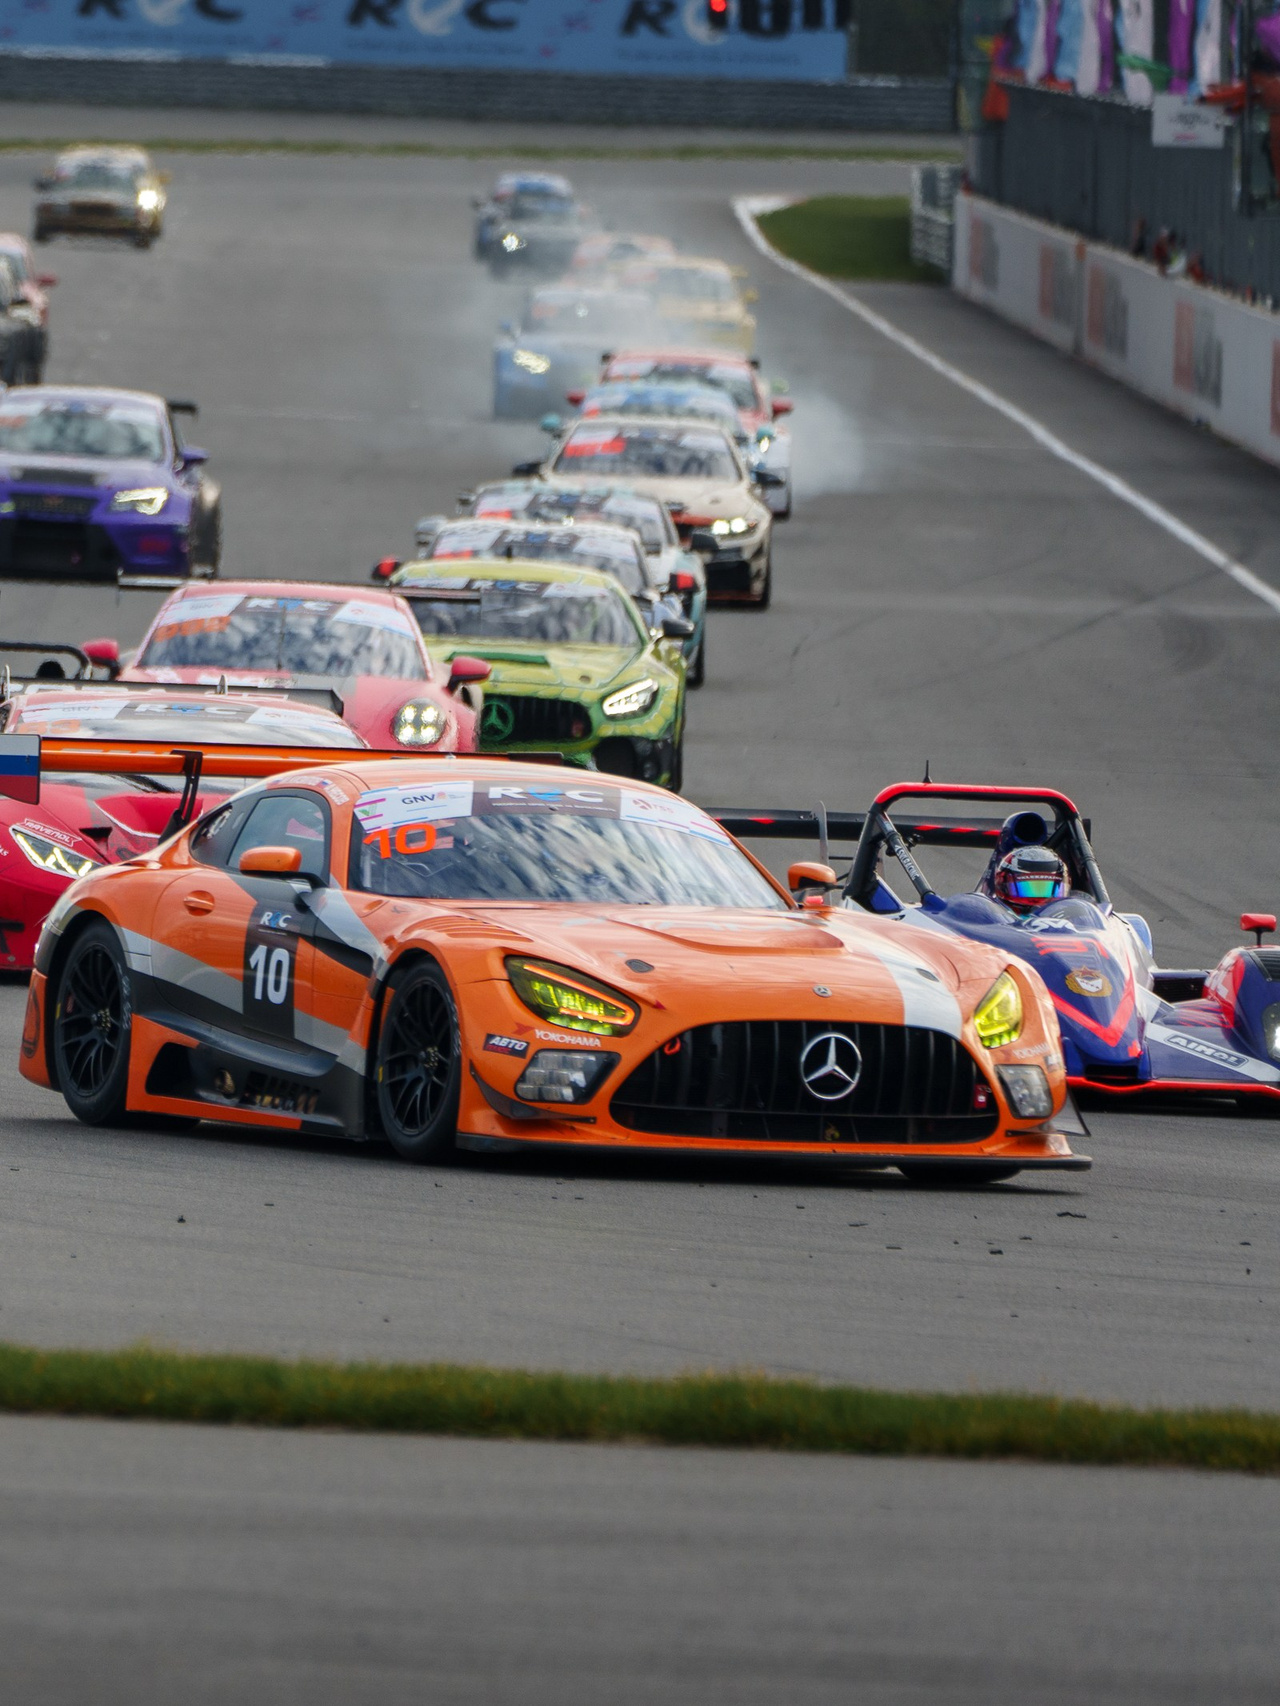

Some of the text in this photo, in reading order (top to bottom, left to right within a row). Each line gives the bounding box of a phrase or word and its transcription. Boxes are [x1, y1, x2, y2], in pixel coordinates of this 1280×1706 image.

[401, 793, 436, 805] GNV
[25, 820, 73, 843] RAVENOL
[362, 822, 437, 860] 10
[249, 944, 290, 1005] 10
[534, 1028, 602, 1048] YOKOHAMA
